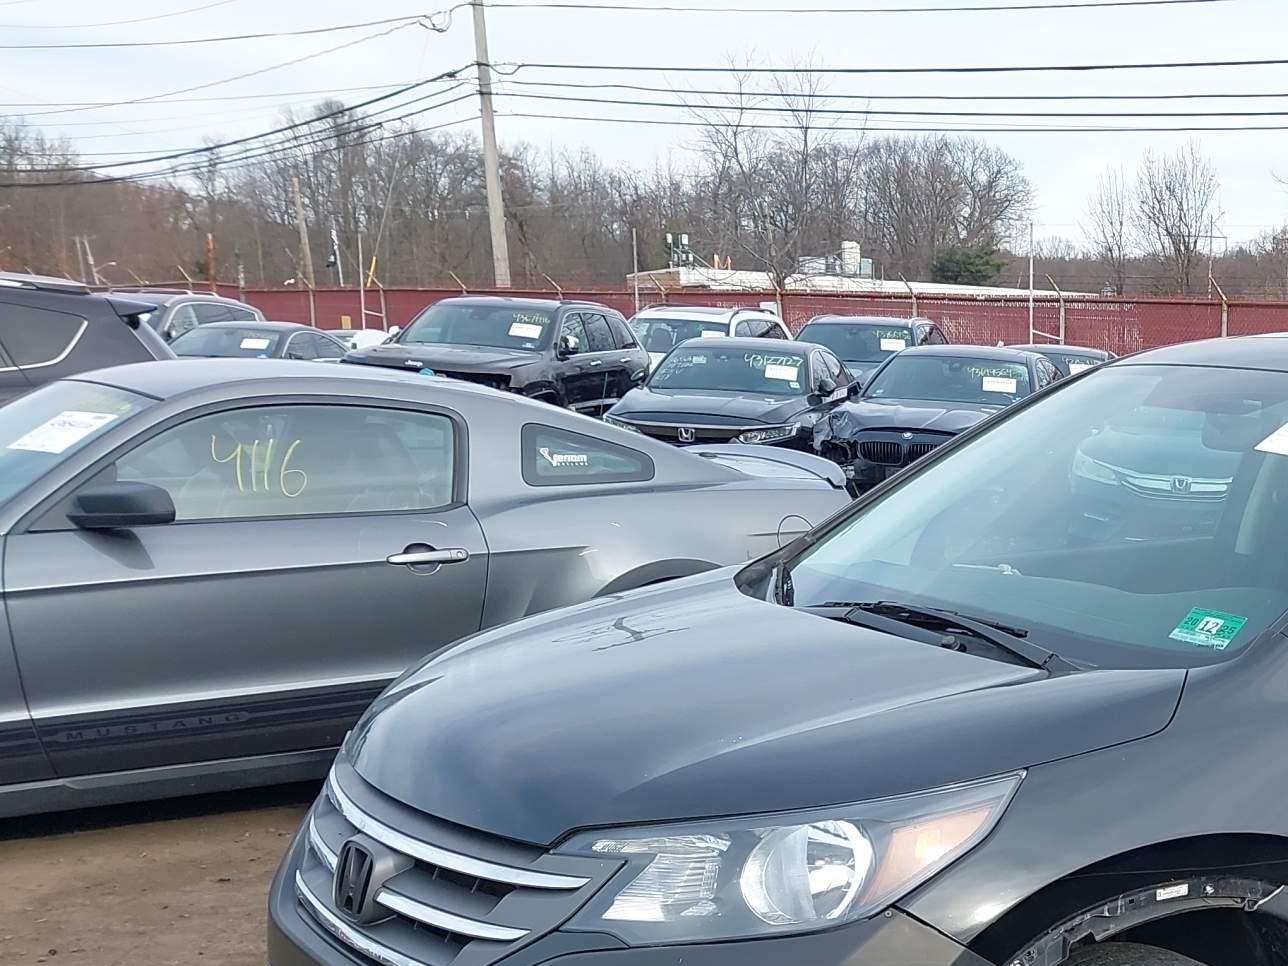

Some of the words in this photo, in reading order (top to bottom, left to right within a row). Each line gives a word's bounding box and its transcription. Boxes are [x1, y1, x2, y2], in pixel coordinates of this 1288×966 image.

[211, 434, 307, 497] 4116
[1198, 620, 1219, 633] 12
[66, 713, 241, 741] MUSTANG
